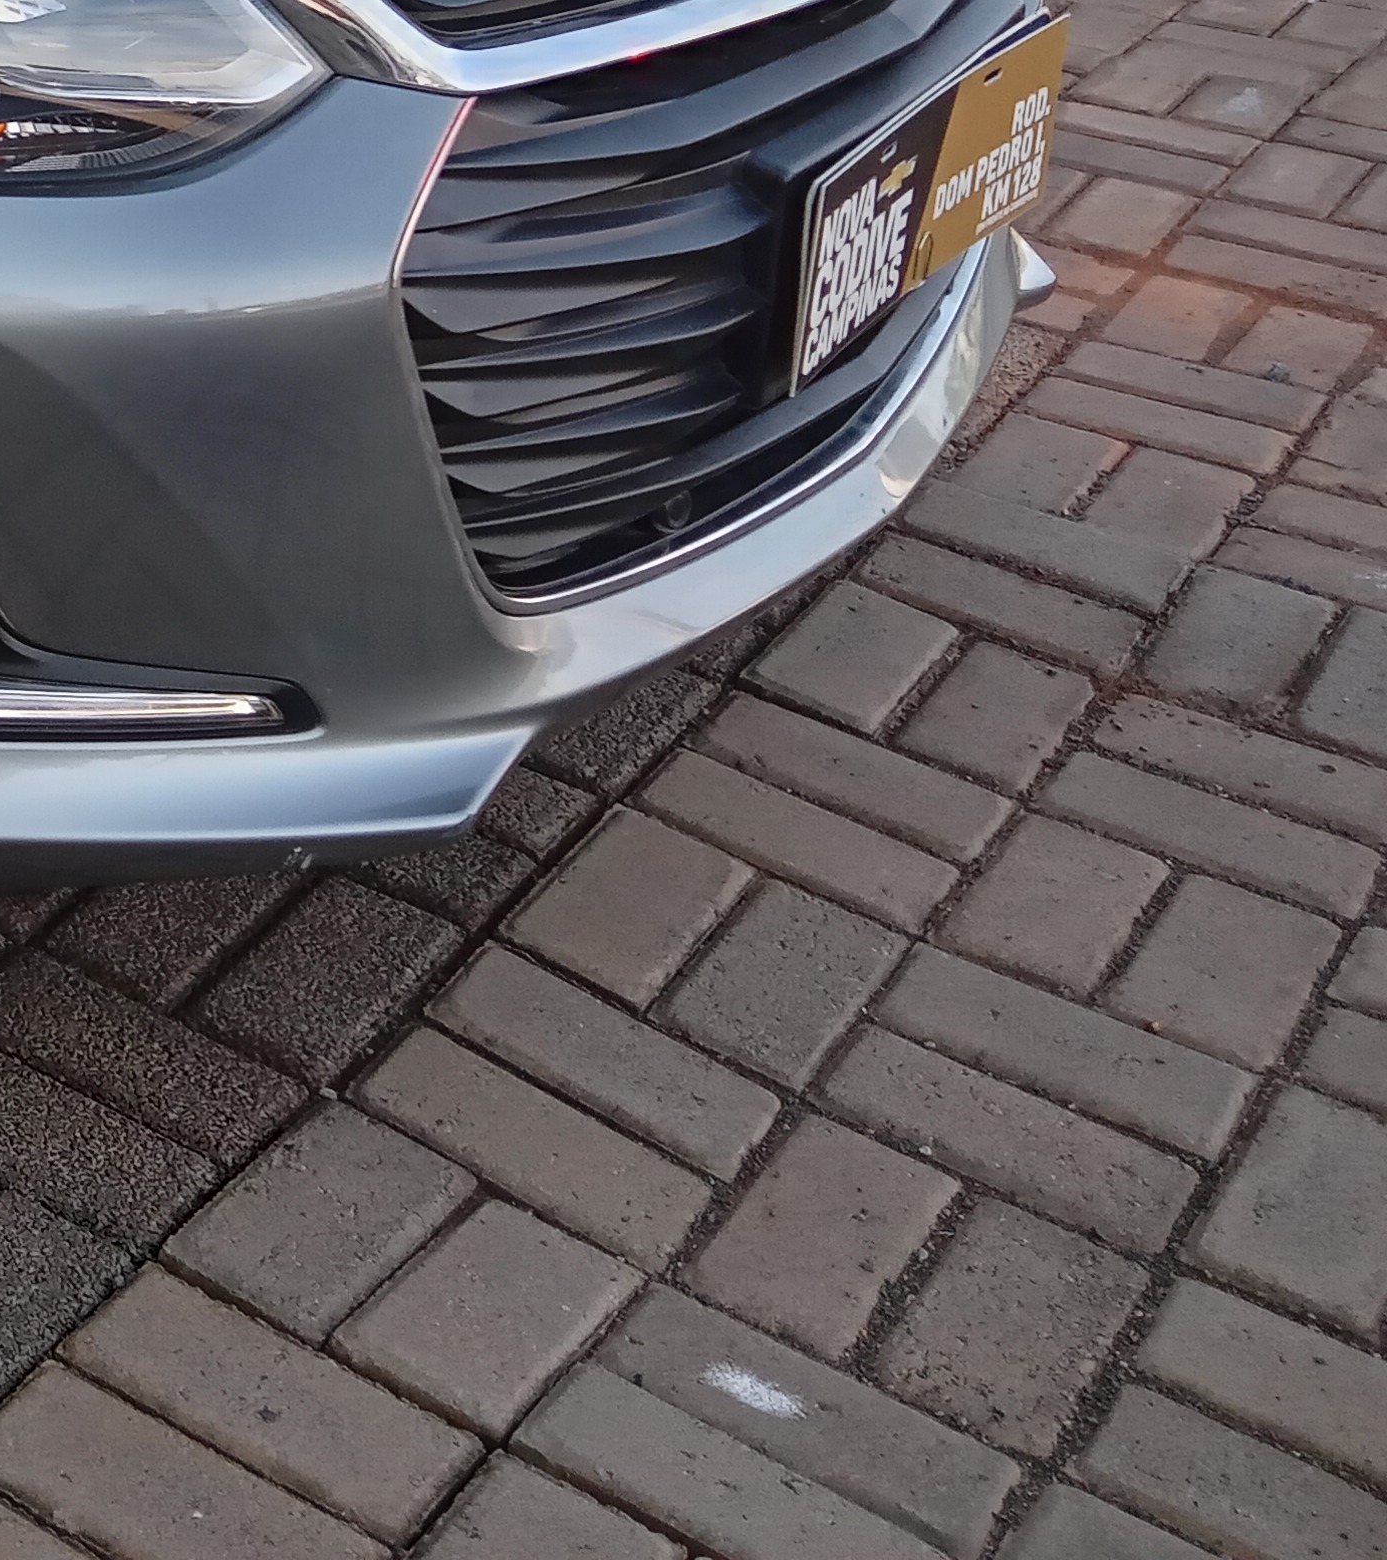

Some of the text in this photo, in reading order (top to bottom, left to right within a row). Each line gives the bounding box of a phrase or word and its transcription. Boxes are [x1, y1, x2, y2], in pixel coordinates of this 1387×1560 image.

[1011, 86, 1052, 136] ROD.
[933, 164, 975, 220] DOM
[974, 127, 1034, 192] PEDRO
[981, 173, 1012, 220] KM
[1013, 154, 1043, 200] 128
[810, 188, 914, 329] CODIVE
[818, 176, 878, 269] NOVA
[801, 253, 903, 376] CAMPINAS
